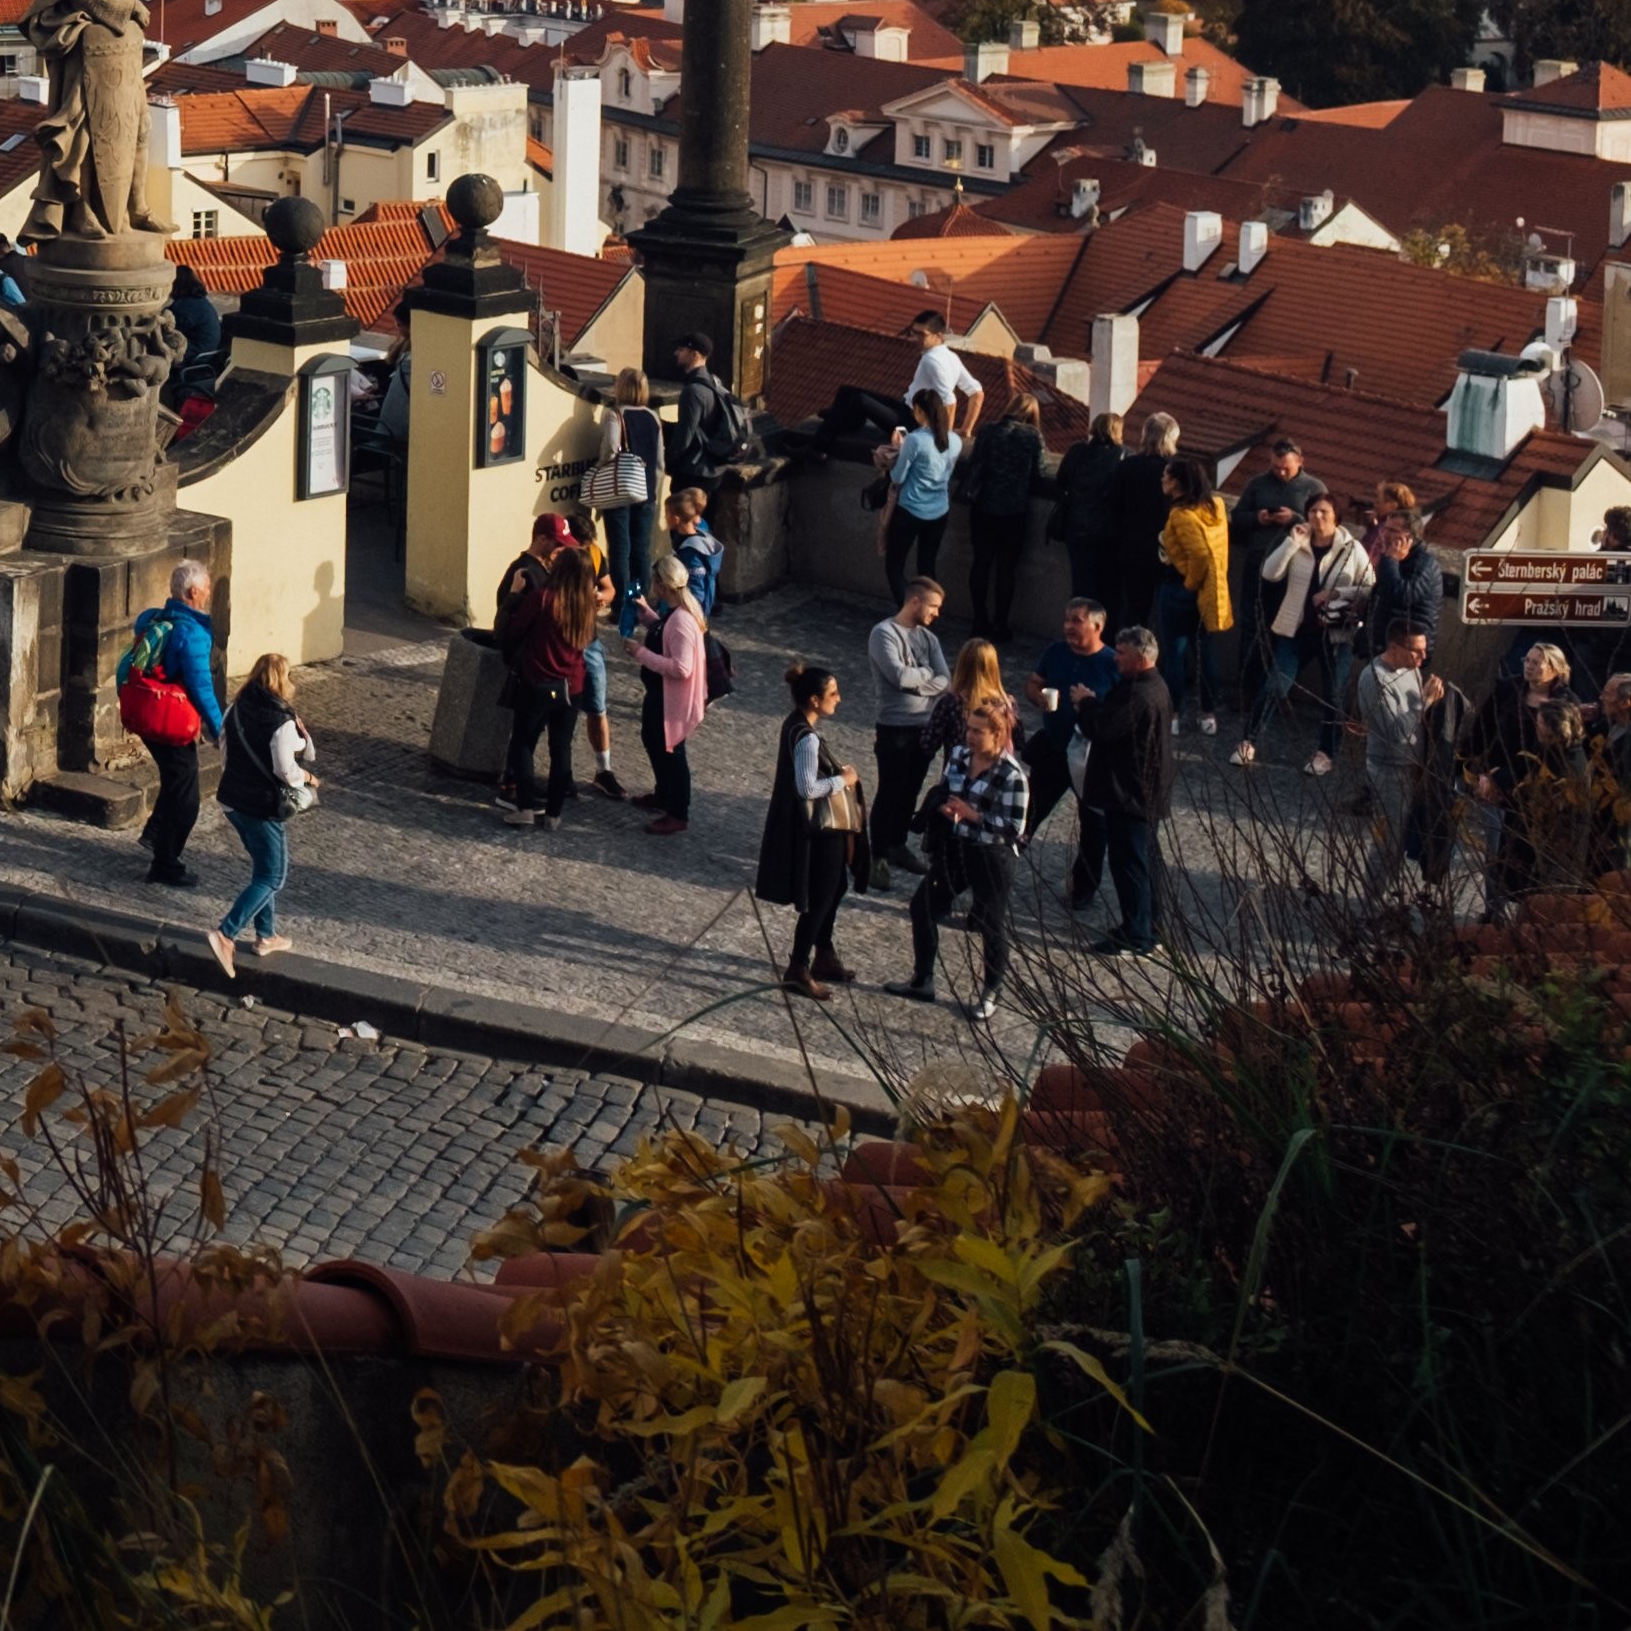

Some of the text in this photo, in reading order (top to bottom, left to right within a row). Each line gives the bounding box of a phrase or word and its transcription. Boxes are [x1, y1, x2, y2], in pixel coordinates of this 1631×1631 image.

[1498, 558, 1603, 583] Šternberský palác
[1524, 598, 1601, 618] Pražský hrad
